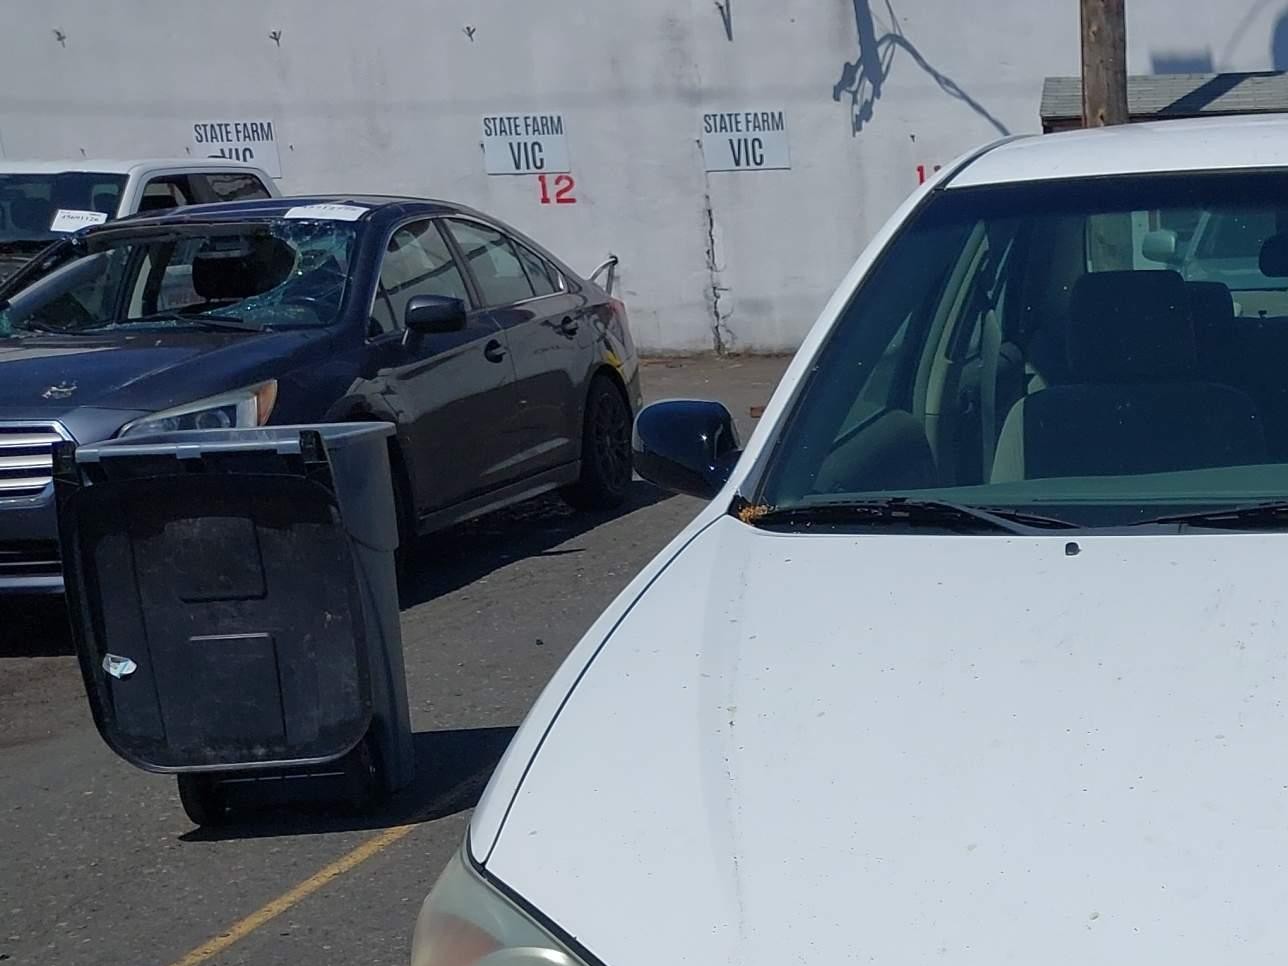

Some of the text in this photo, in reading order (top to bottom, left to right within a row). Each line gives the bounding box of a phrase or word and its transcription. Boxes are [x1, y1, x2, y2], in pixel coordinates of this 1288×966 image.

[194, 122, 274, 143] STATE FARM
[483, 115, 564, 136] STATE FARM
[704, 112, 784, 134] STATE FARM
[508, 141, 545, 170] VIC
[728, 138, 764, 167] VIC
[538, 175, 577, 204] 12
